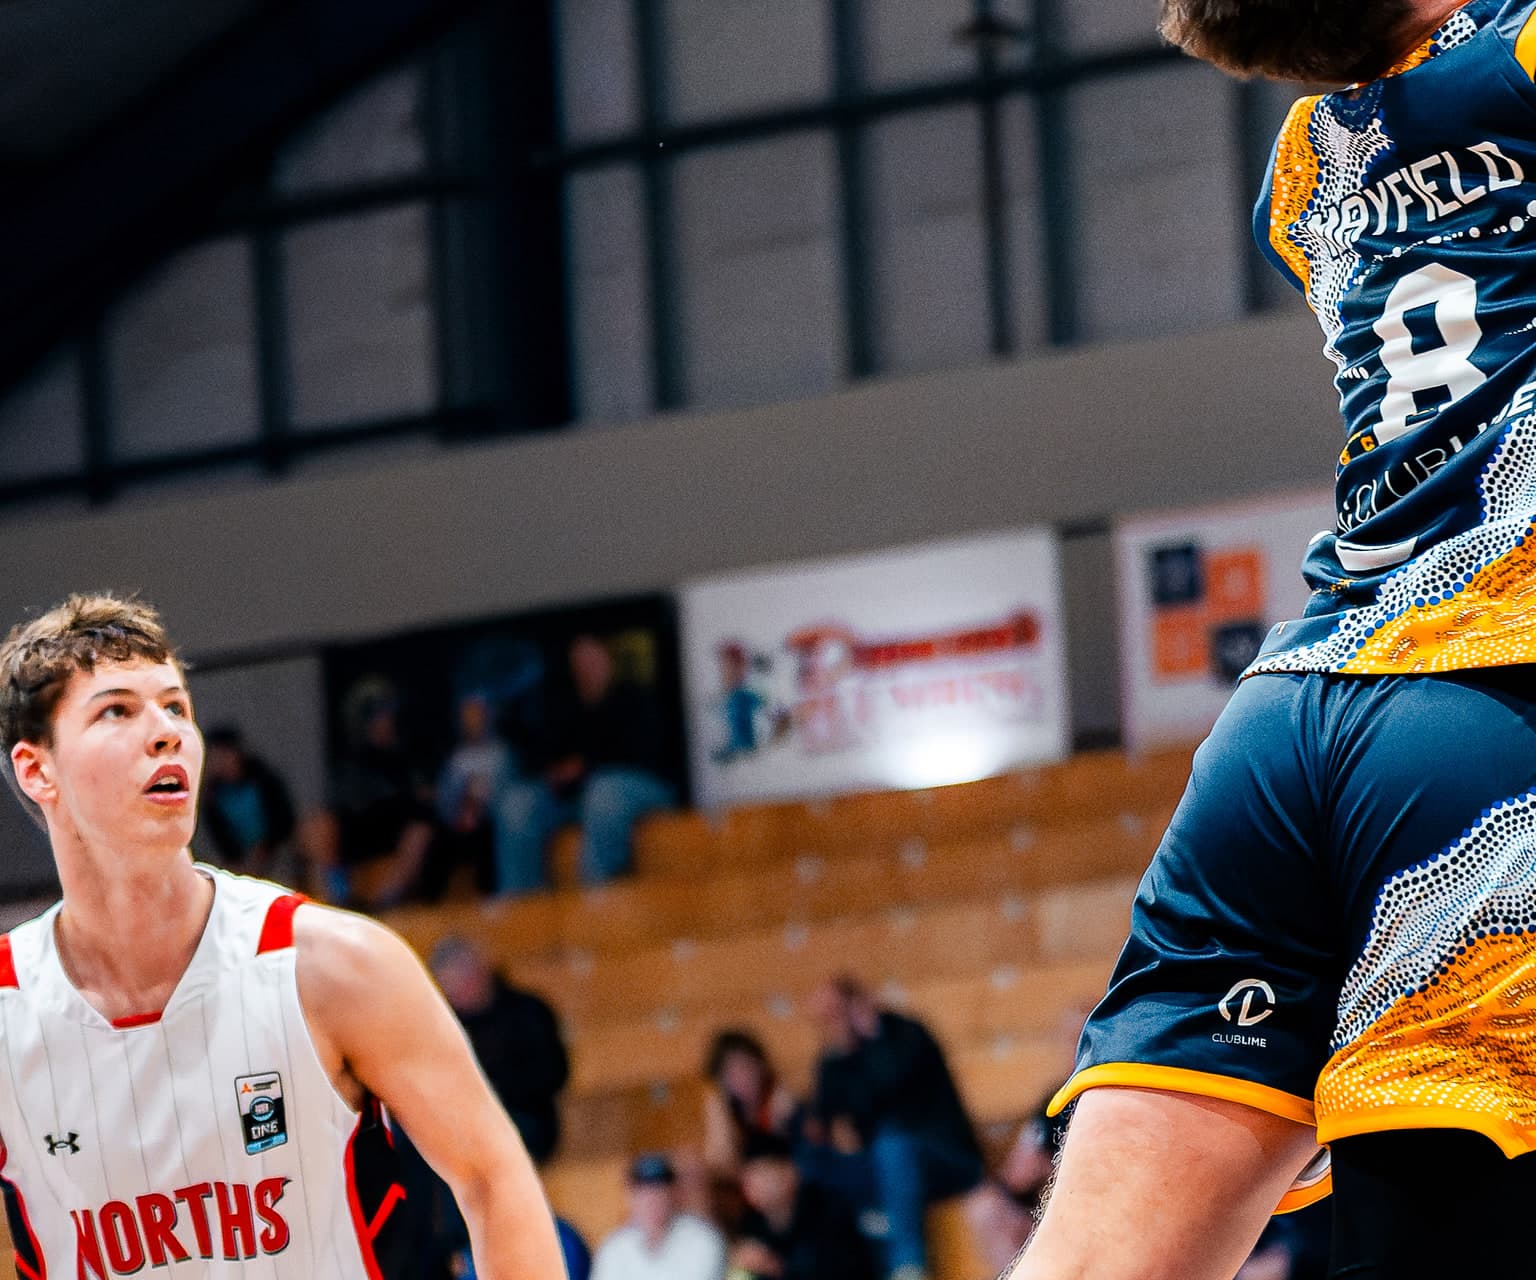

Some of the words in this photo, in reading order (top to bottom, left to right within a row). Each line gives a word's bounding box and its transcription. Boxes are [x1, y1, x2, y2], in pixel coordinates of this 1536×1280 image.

[1306, 140, 1525, 260] MAYFIELD
[1372, 261, 1488, 448] 8
[1211, 1032, 1268, 1049] CLUBLIME
